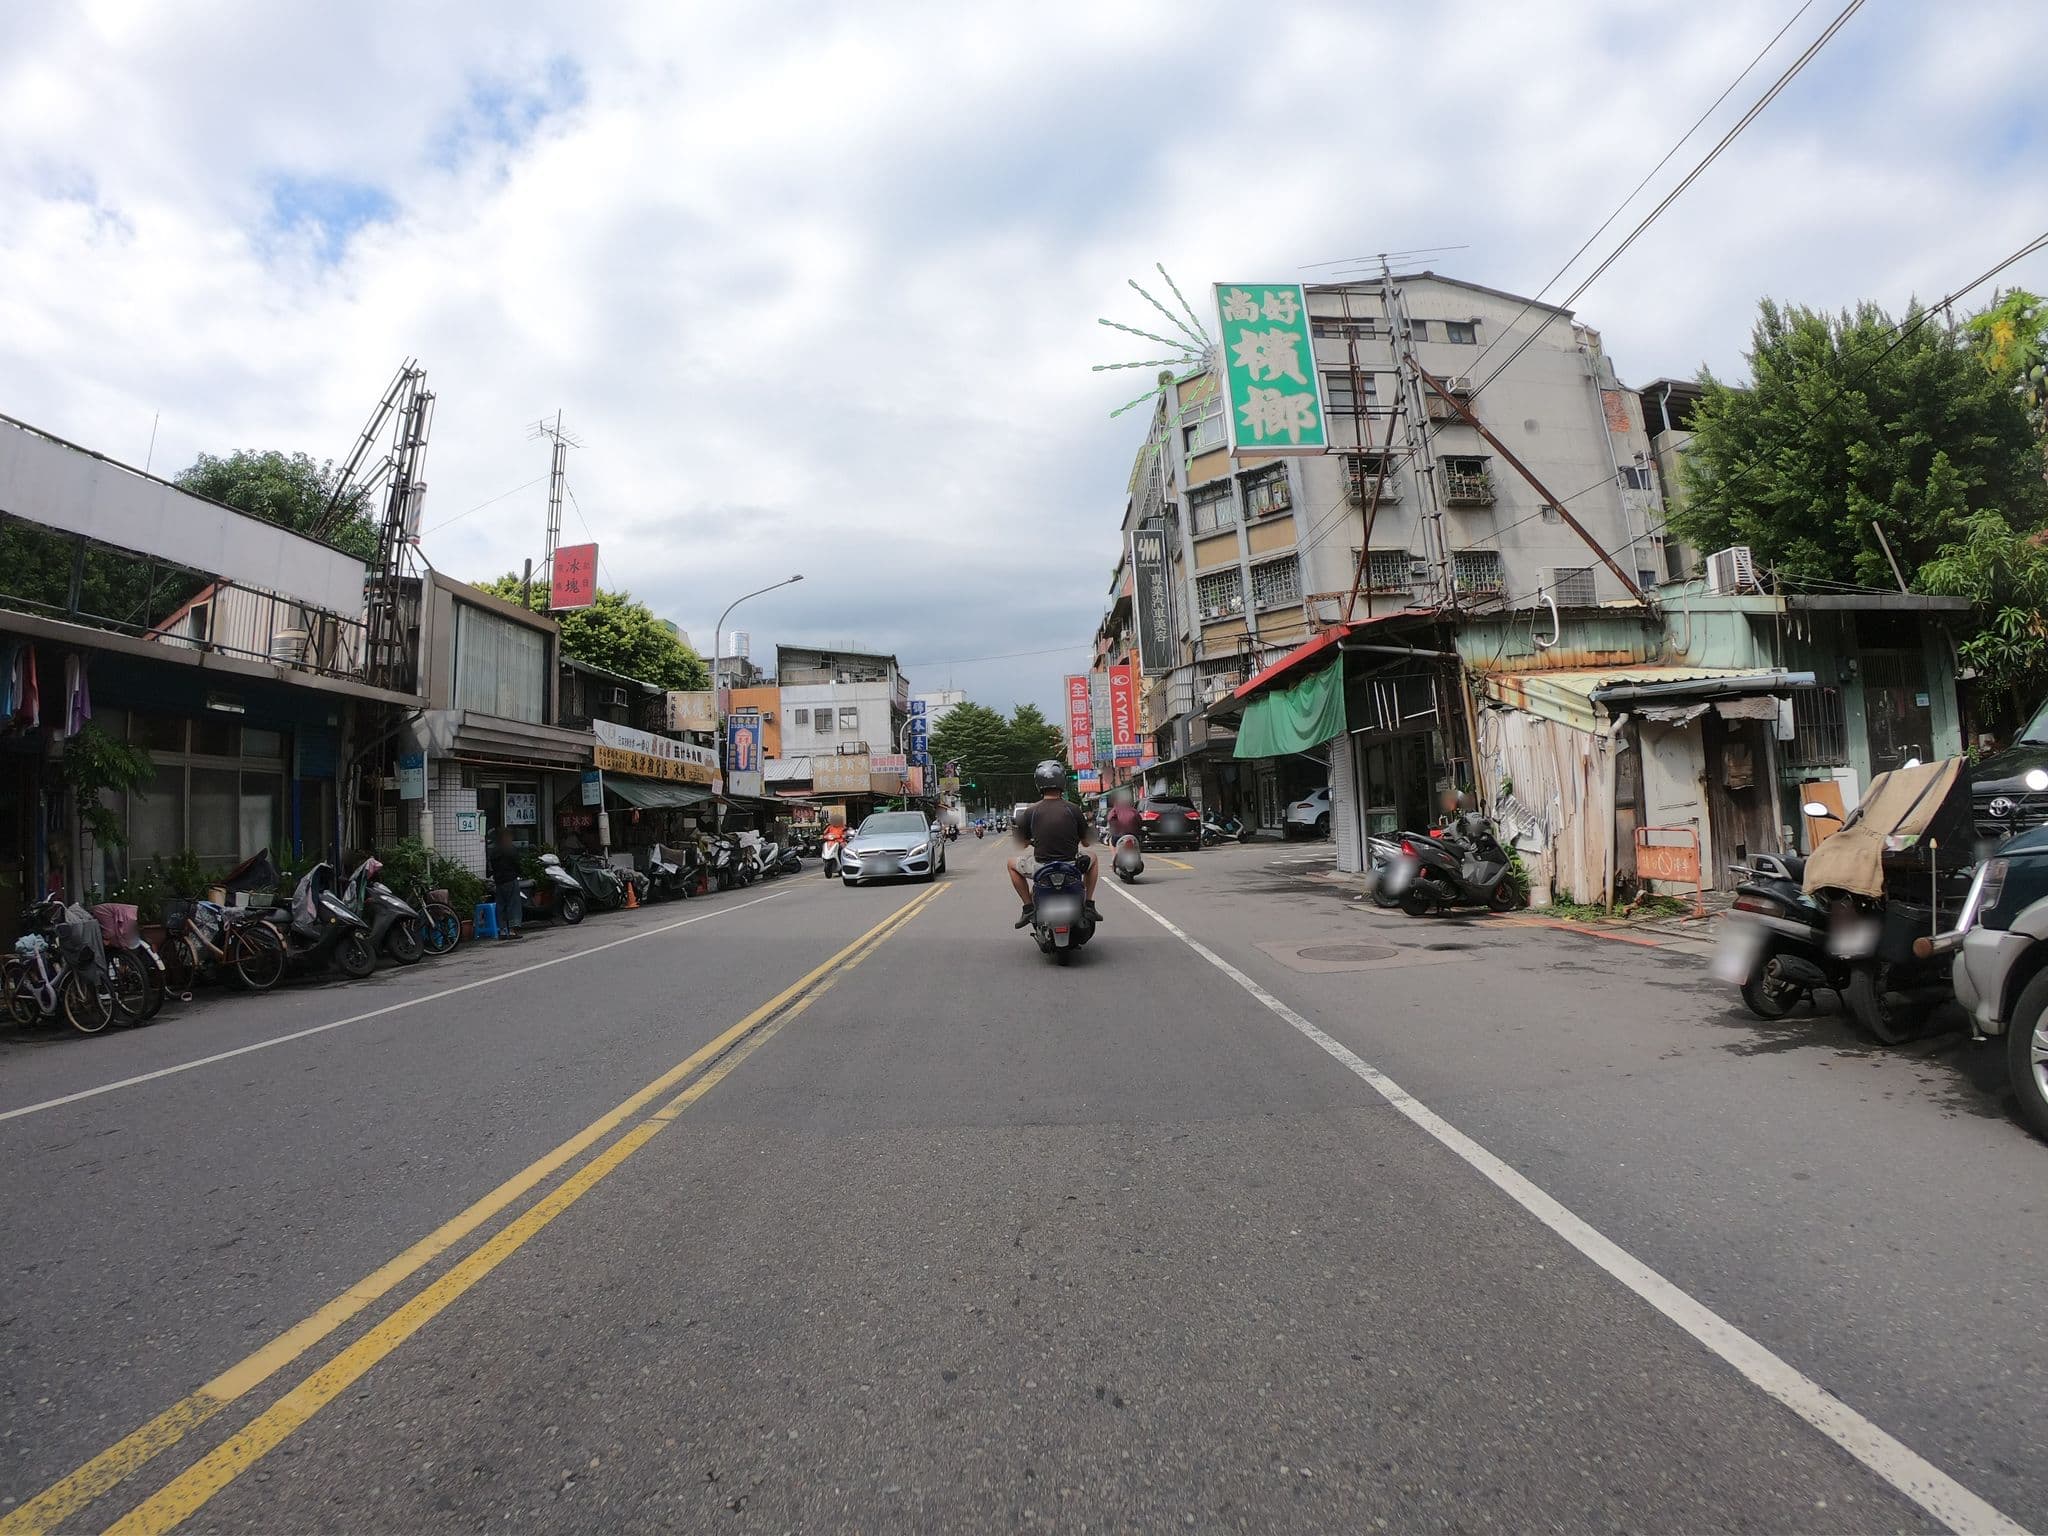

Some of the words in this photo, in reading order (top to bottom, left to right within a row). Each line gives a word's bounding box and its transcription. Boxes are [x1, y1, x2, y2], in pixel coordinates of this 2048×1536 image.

[1223, 287, 1301, 325] 尚好
[1230, 327, 1318, 444] 檳榔
[462, 820, 473, 830] 94
